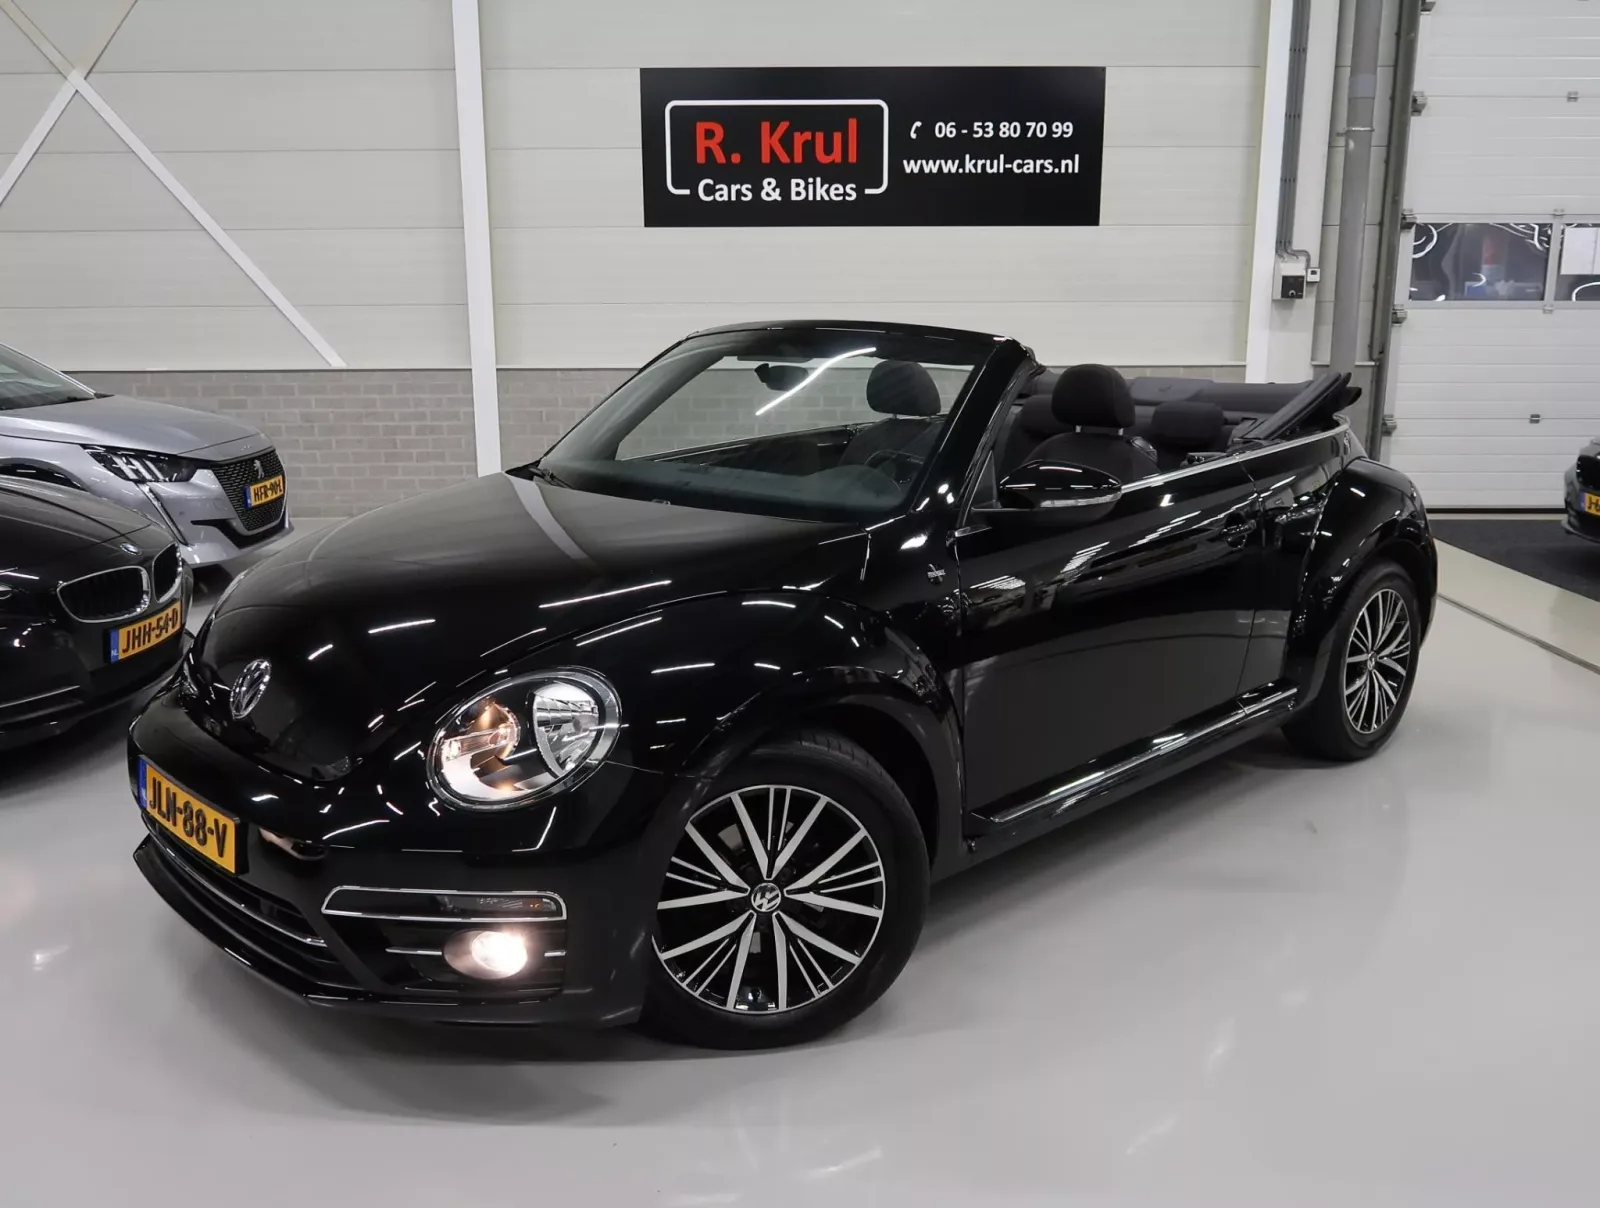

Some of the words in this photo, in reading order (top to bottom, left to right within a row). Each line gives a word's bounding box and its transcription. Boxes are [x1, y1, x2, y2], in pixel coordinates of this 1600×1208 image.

[695, 121, 741, 164] R.
[760, 117, 858, 164] Krul
[934, 121, 957, 138] 06
[972, 121, 994, 138] 53
[998, 121, 1021, 138] 80
[1025, 121, 1047, 138] 70
[1051, 121, 1074, 138] 99
[902, 153, 1080, 174] www.krul-cars.nl
[698, 178, 753, 201] Cars
[760, 177, 782, 201] &
[790, 177, 857, 201] Bikes
[122, 607, 178, 653] JHH-54-D
[149, 776, 227, 859] JLN-88-V
